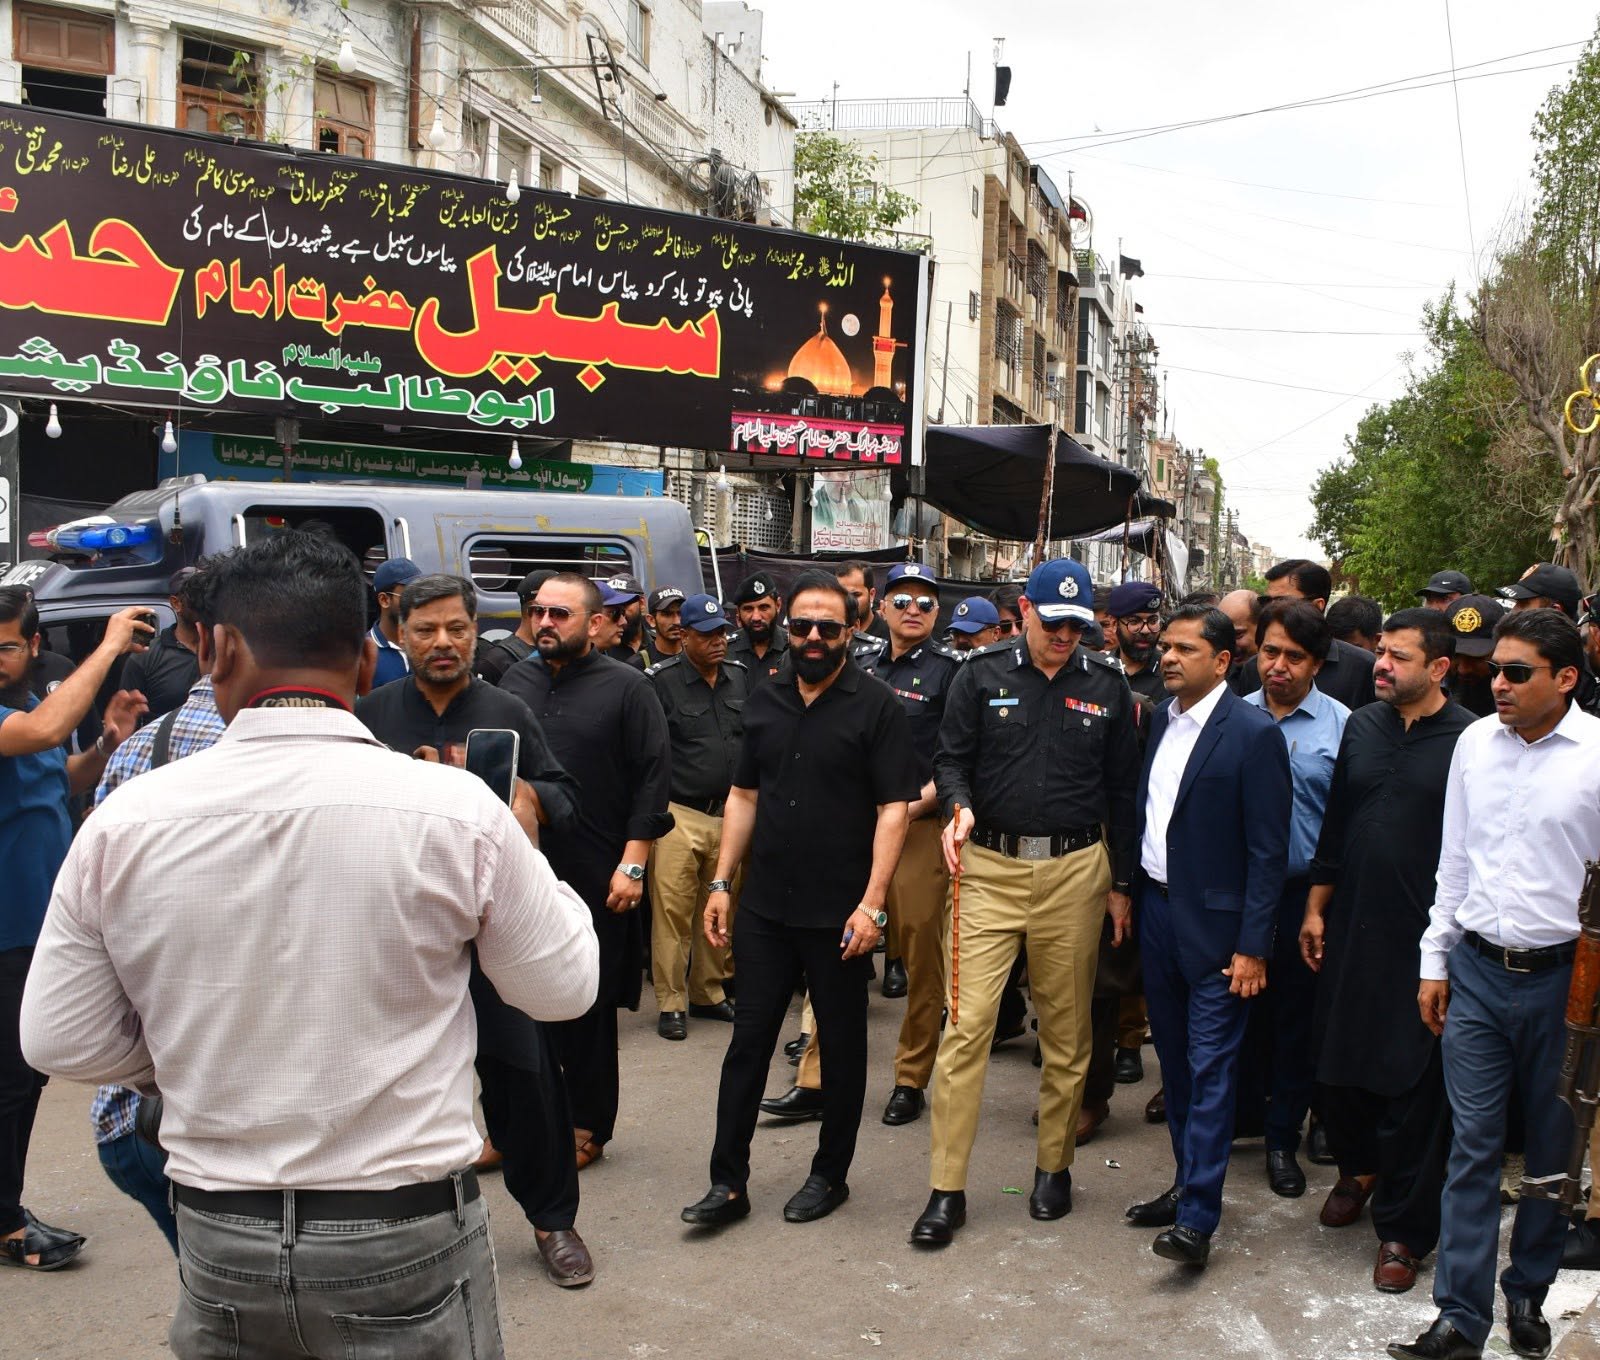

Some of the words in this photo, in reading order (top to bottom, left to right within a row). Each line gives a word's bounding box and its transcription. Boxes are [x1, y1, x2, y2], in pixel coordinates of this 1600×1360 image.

[15, 126, 46, 175] تقی
[34, 141, 63, 172] محمد
[112, 149, 134, 177] رضا
[135, 144, 156, 184] علی
[196, 158, 224, 197] کاظم
[224, 169, 255, 195] موسیٰ
[290, 172, 324, 204] صادق
[320, 181, 348, 211] جعفر
[370, 183, 395, 223] باقر
[396, 192, 417, 217] محمد
[183, 204, 204, 241] کی
[233, 213, 267, 241] کے
[439, 203, 491, 228] العابدین
[491, 211, 518, 234] زین
[534, 209, 572, 240] حسین
[207, 214, 234, 247] نام
[269, 224, 332, 253] شہیدوں
[595, 223, 629, 251] حسن
[653, 226, 681, 258] فاطمہ
[326, 244, 340, 259] یہ
[342, 239, 371, 264] ہے
[373, 230, 414, 261] سبیل
[406, 243, 457, 273] پیاسوں
[722, 233, 739, 269] علی
[0, 218, 184, 327] حس
[506, 245, 527, 282] کی
[557, 262, 593, 294] امام
[787, 252, 805, 280] محمد
[826, 251, 854, 287] اللہ
[195, 258, 286, 321] امام
[598, 270, 639, 300] پیاس
[671, 278, 689, 306] یاد
[694, 277, 708, 302] تو
[706, 289, 724, 309] پیو
[729, 277, 754, 318] پانی
[287, 274, 416, 336] حضرت
[414, 244, 721, 392] سبیل
[0, 336, 285, 404] فاؤنڈیش
[282, 343, 341, 371] السلام
[341, 350, 382, 376] علیہ
[777, 421, 808, 447] حسین
[800, 428, 818, 454] امام
[818, 431, 849, 453] حضرت
[847, 427, 878, 457] مبارک
[221, 442, 266, 464] فرمایا
[362, 456, 393, 473] علیہ
[394, 453, 416, 473] اللہ
[416, 459, 450, 477] صلی
[489, 465, 531, 483] حضرت
[607, 579, 628, 590] LICE
